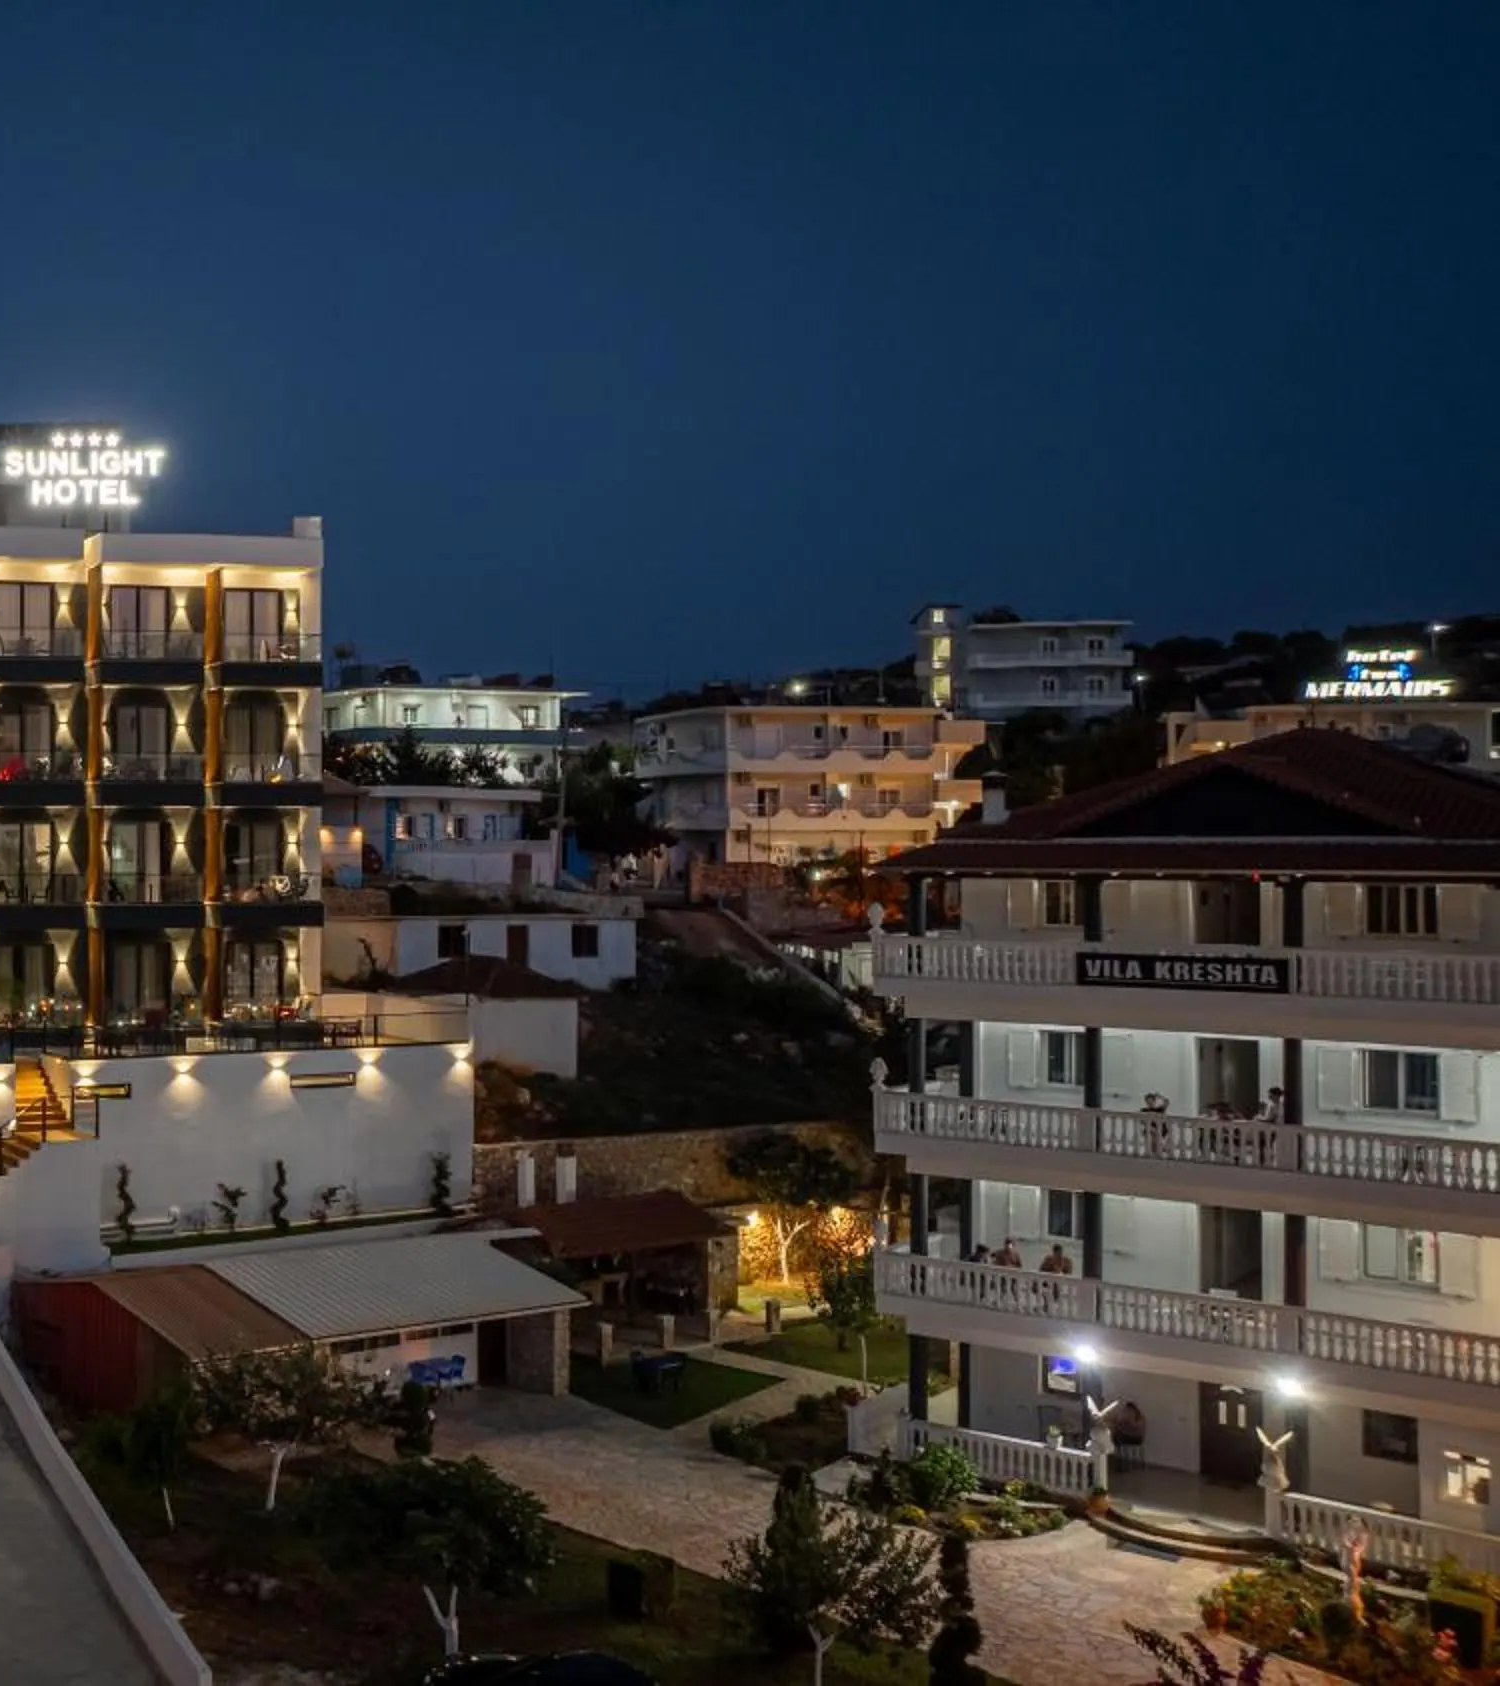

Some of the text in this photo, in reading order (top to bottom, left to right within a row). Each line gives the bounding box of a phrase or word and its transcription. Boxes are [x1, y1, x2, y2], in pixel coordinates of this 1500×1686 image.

[4, 449, 166, 478] SUNLIGHT
[30, 478, 141, 506] HOTEL
[1304, 679, 1457, 699] MERMAIDS
[1085, 959, 1280, 985] VILA KRESHTA
